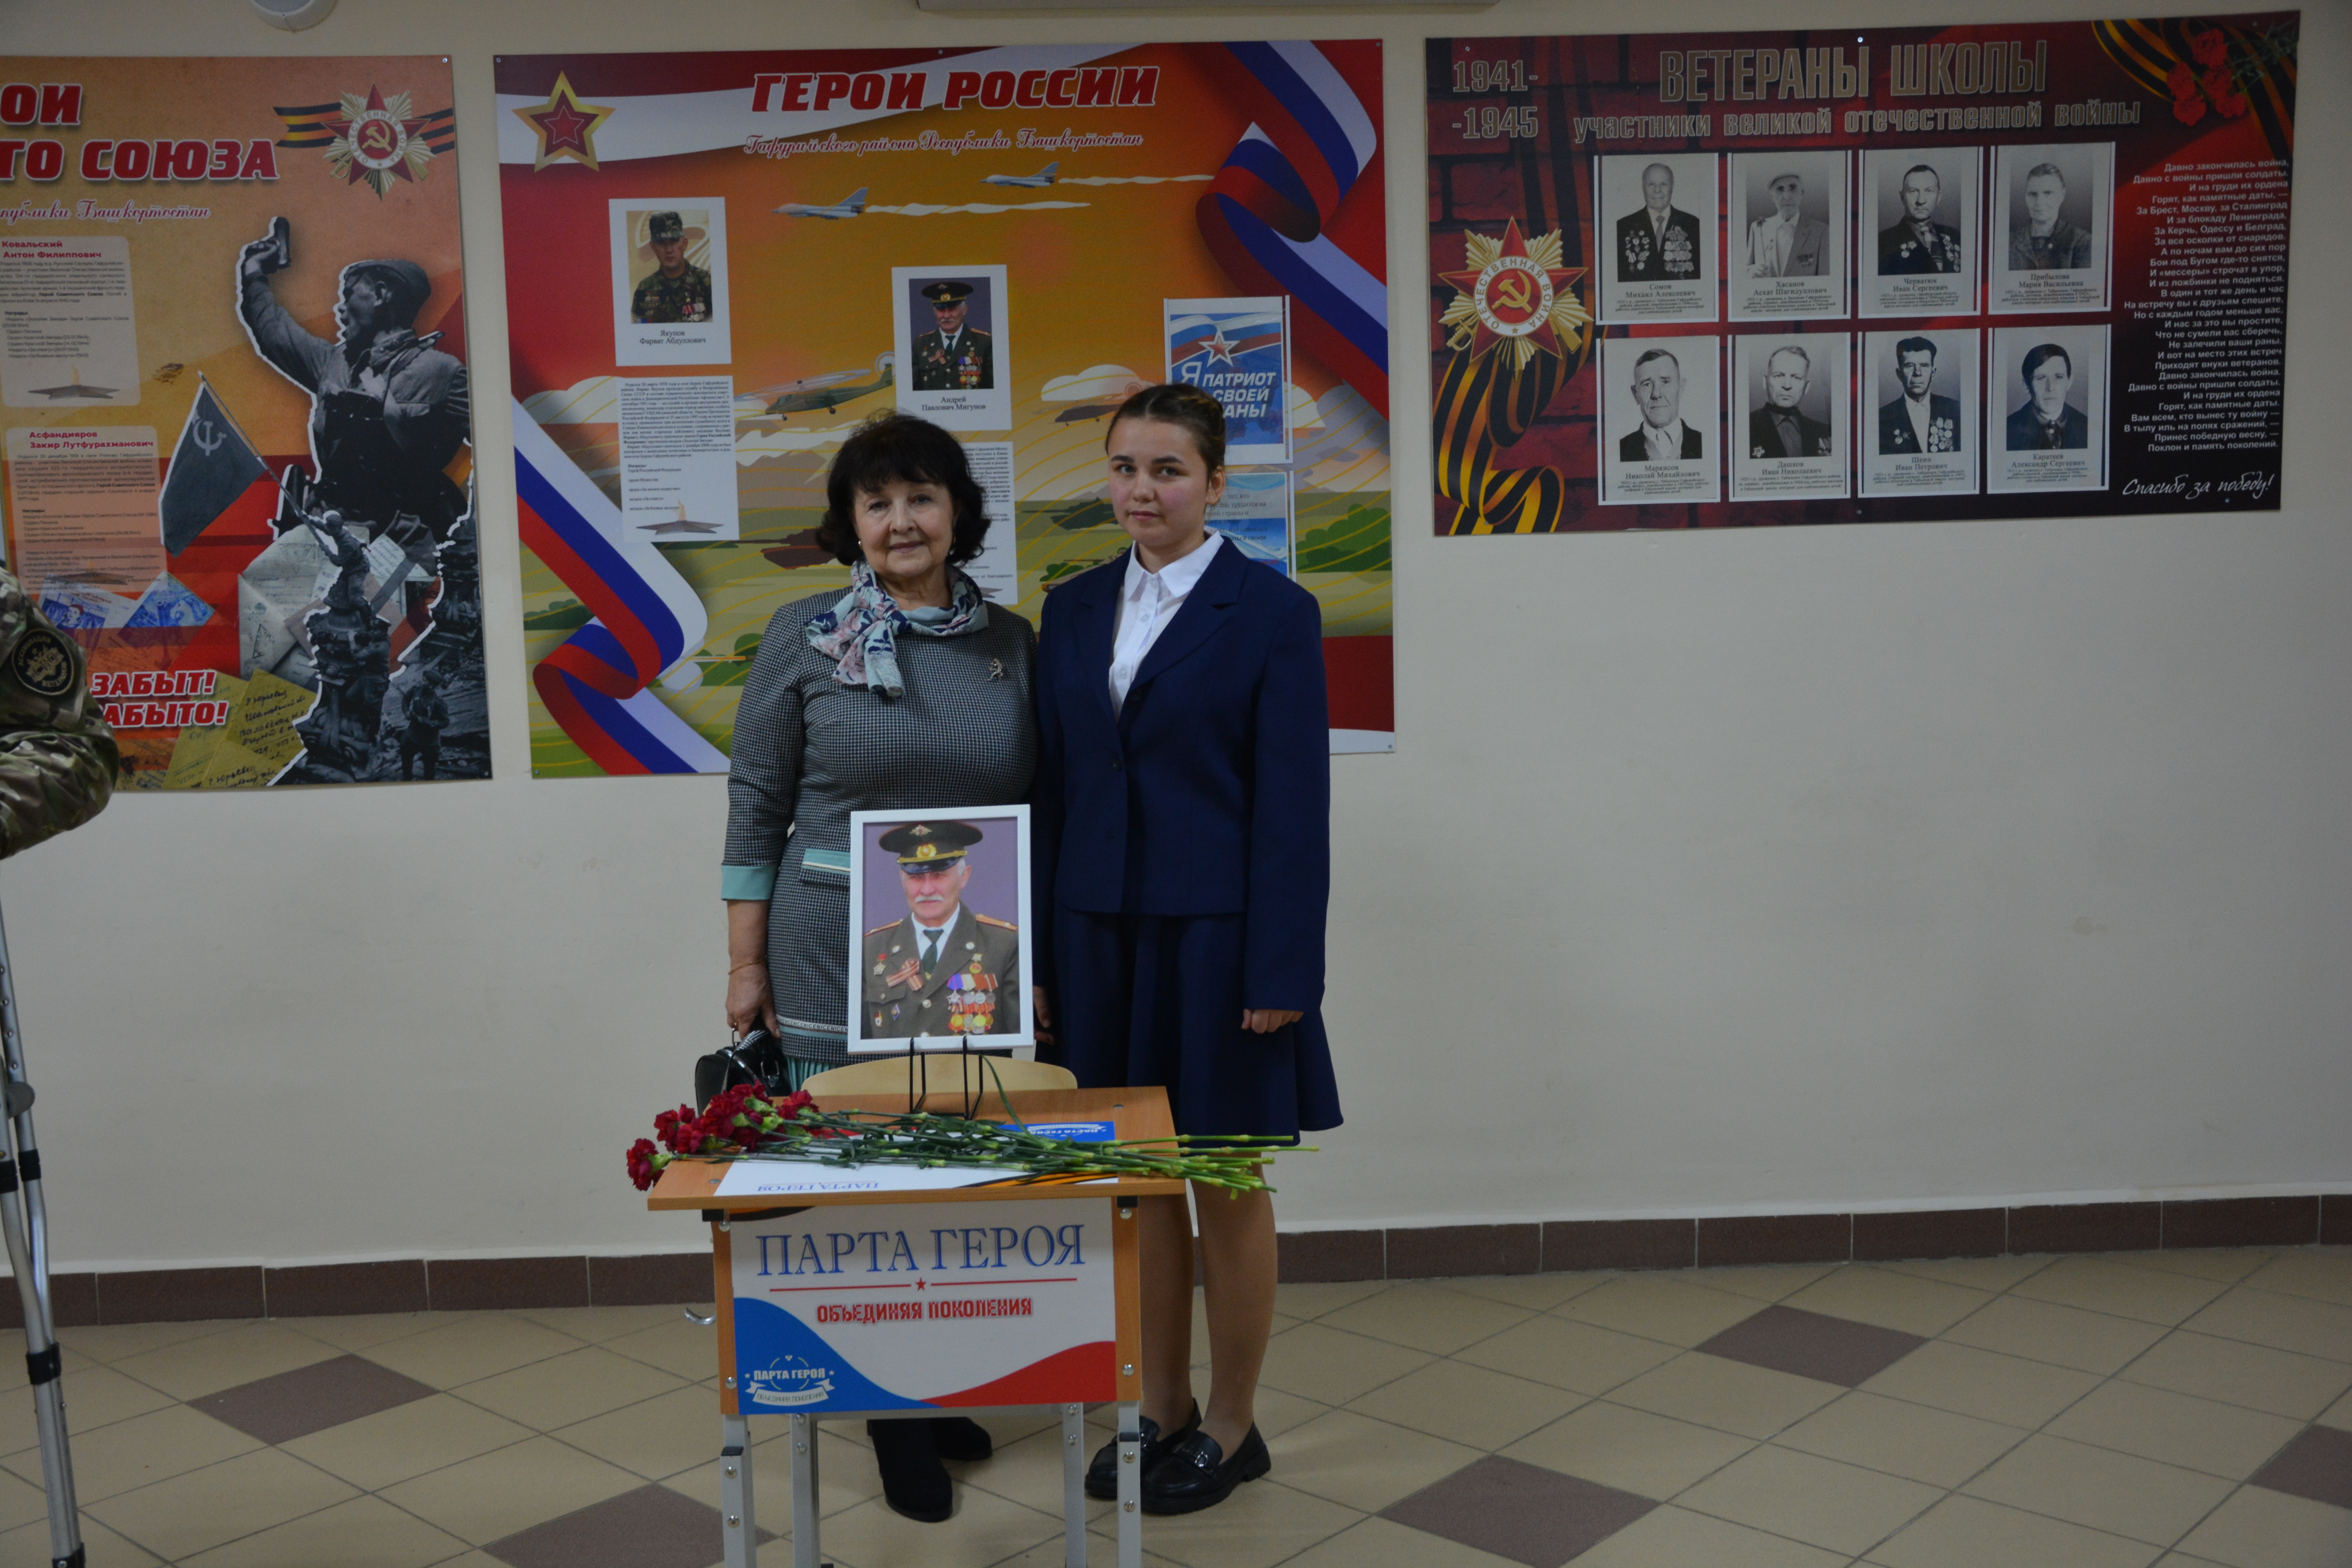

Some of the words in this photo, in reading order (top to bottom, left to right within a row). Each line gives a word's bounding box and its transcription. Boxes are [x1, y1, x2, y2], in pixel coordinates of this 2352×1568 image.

[1452, 59, 1539, 93] 1941-
[1660, 45, 1869, 102] ВЕТЕРАНЫ
[1890, 40, 2047, 97] ШКОЛЫ
[751, 72, 927, 113] ГЕРОИ
[943, 65, 1160, 110] РОССИИ
[1452, 105, 1539, 139] -1945
[1573, 114, 1711, 143] участники
[1724, 108, 1831, 136] великой
[1844, 100, 2041, 134] отечественной
[2054, 98, 2140, 127] войны
[349, 111, 399, 164] ОТЕЧЕСТВЕННАЯ
[744, 134, 858, 159] Гафурийского
[858, 137, 916, 156] района
[919, 130, 1011, 155] Республики
[1016, 127, 1143, 154] Башкортостан
[80, 139, 280, 181] СОЮЗА
[2164, 163, 2194, 173] Давно
[2196, 162, 2256, 171] закончилась
[2258, 159, 2288, 167] война,
[2189, 183, 2196, 192] И
[2212, 183, 2238, 192] груди
[2254, 181, 2288, 190] ордена
[77, 199, 211, 226] Башкортостан
[2136, 206, 2148, 215] За
[2150, 206, 2179, 215] Брест,
[2181, 205, 2217, 213] Москву,
[2232, 202, 2288, 211] Сталинград
[2154, 227, 2165, 235] За
[2168, 226, 2198, 235] Керчь,
[2200, 225, 2234, 234] Одессу
[2245, 223, 2286, 231] Белград,
[2160, 247, 2168, 256] А
[2150, 269, 2157, 277] И
[1475, 258, 1545, 329] ОТЕЧЕСТВЕННАЯ
[2200, 298, 2239, 307] друзьям
[2242, 327, 2282, 336] сберечь,
[2158, 351, 2164, 359] И
[1181, 361, 1202, 387] Я
[1202, 372, 1276, 387] ПАТРИОТ
[2158, 372, 2188, 381] Давно
[2190, 370, 2248, 379] закончилась
[2250, 368, 2280, 376] война.
[1213, 387, 1269, 403] СВОЕЙ
[956, 403, 986, 411] Мигунов
[1223, 403, 1267, 419] АНЫ
[63, 441, 153, 449] Лутфурахманович
[2148, 444, 2181, 452] Поклон
[2227, 440, 2278, 449] поколений.
[2122, 474, 2189, 495] Спасибо
[2185, 481, 2211, 499] за
[2217, 470, 2275, 499] победу!
[91, 670, 216, 698] ЗАБЫТ!
[103, 702, 228, 728] АБЫТО!
[755, 1230, 919, 1276] ПАРТА
[930, 1223, 1085, 1270] ГЕРОЯ
[816, 1299, 922, 1325] ОБЪЕДИНЯЯ
[928, 1297, 1033, 1319] ПОКОЛЕНИЯ
[753, 1370, 789, 1381] ПАРТА
[791, 1368, 826, 1379] ГЕРОЯ
